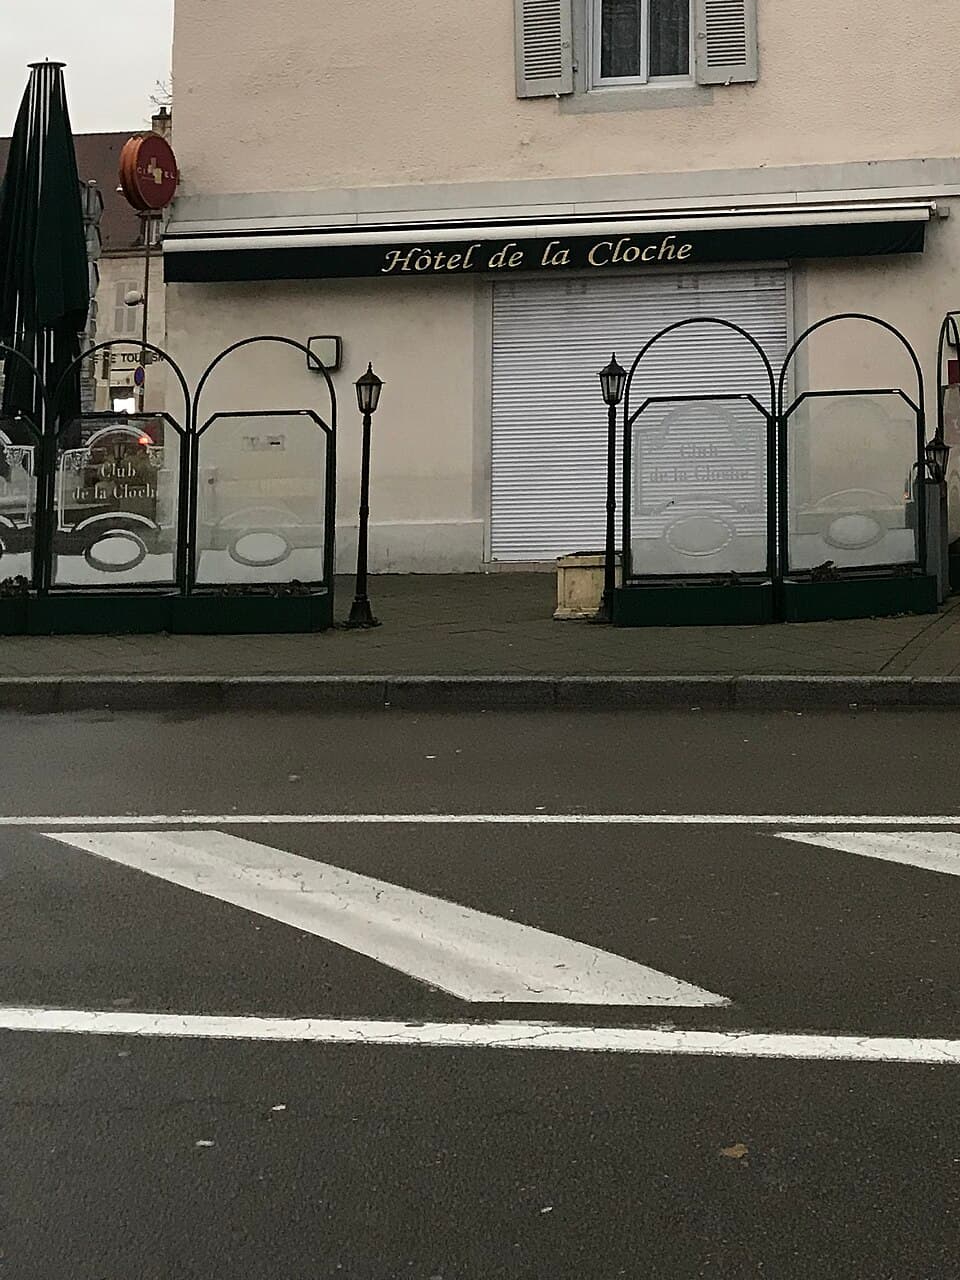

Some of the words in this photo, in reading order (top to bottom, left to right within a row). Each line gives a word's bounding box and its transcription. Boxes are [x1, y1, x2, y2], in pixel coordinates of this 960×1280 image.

[381, 243, 481, 272] Hôtel
[488, 242, 524, 268] de
[541, 240, 571, 266] la
[588, 235, 693, 267] Cloche
[101, 461, 137, 478] Club
[72, 486, 89, 500] de
[94, 484, 107, 500] la
[113, 483, 160, 499] Cloch
